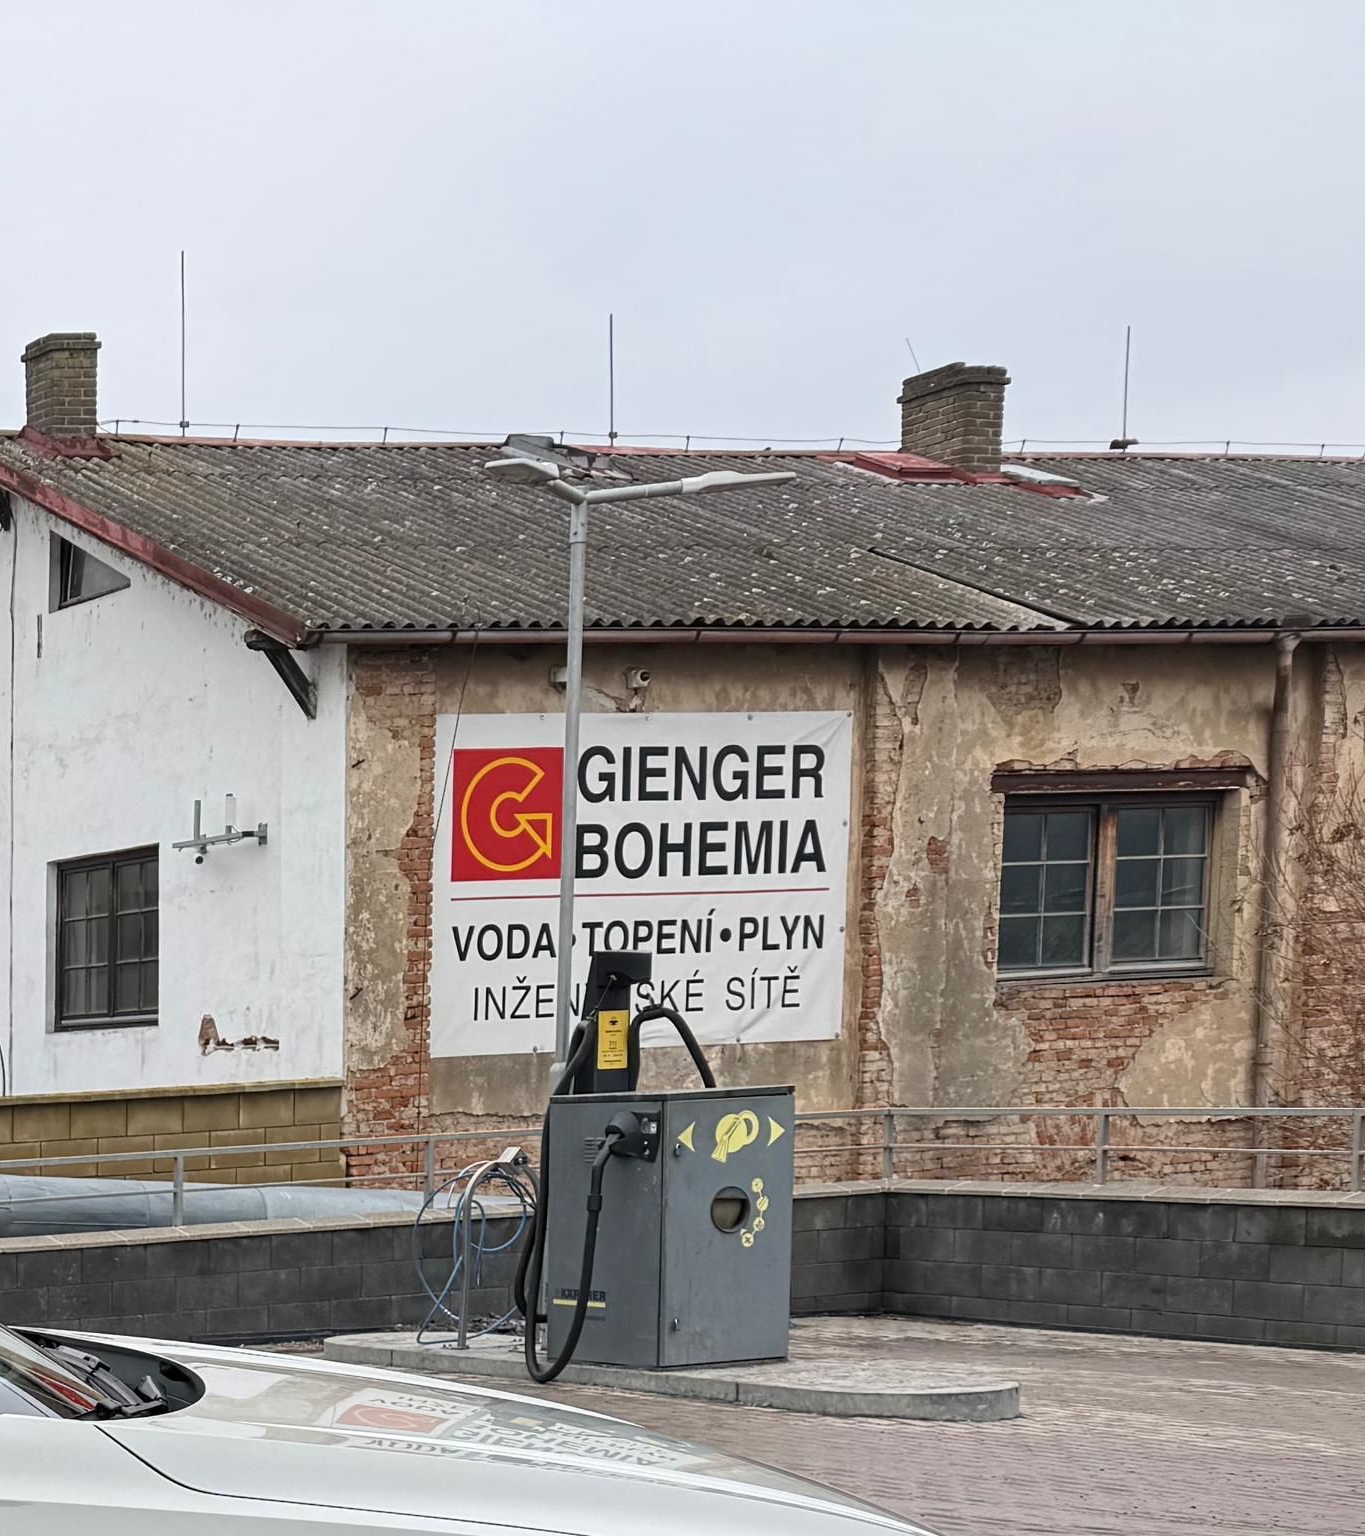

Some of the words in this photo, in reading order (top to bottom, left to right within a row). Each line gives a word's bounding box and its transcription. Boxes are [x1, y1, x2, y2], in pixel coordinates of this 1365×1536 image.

[577, 744, 826, 803] GIENGER
[574, 819, 827, 879] BOHEMIA
[452, 922, 557, 962] VODA
[581, 908, 716, 957] TOPENÍ
[738, 914, 825, 952] PLYN
[473, 969, 705, 1021] INŽESKÉ
[725, 965, 801, 1012] SÍTĚ
